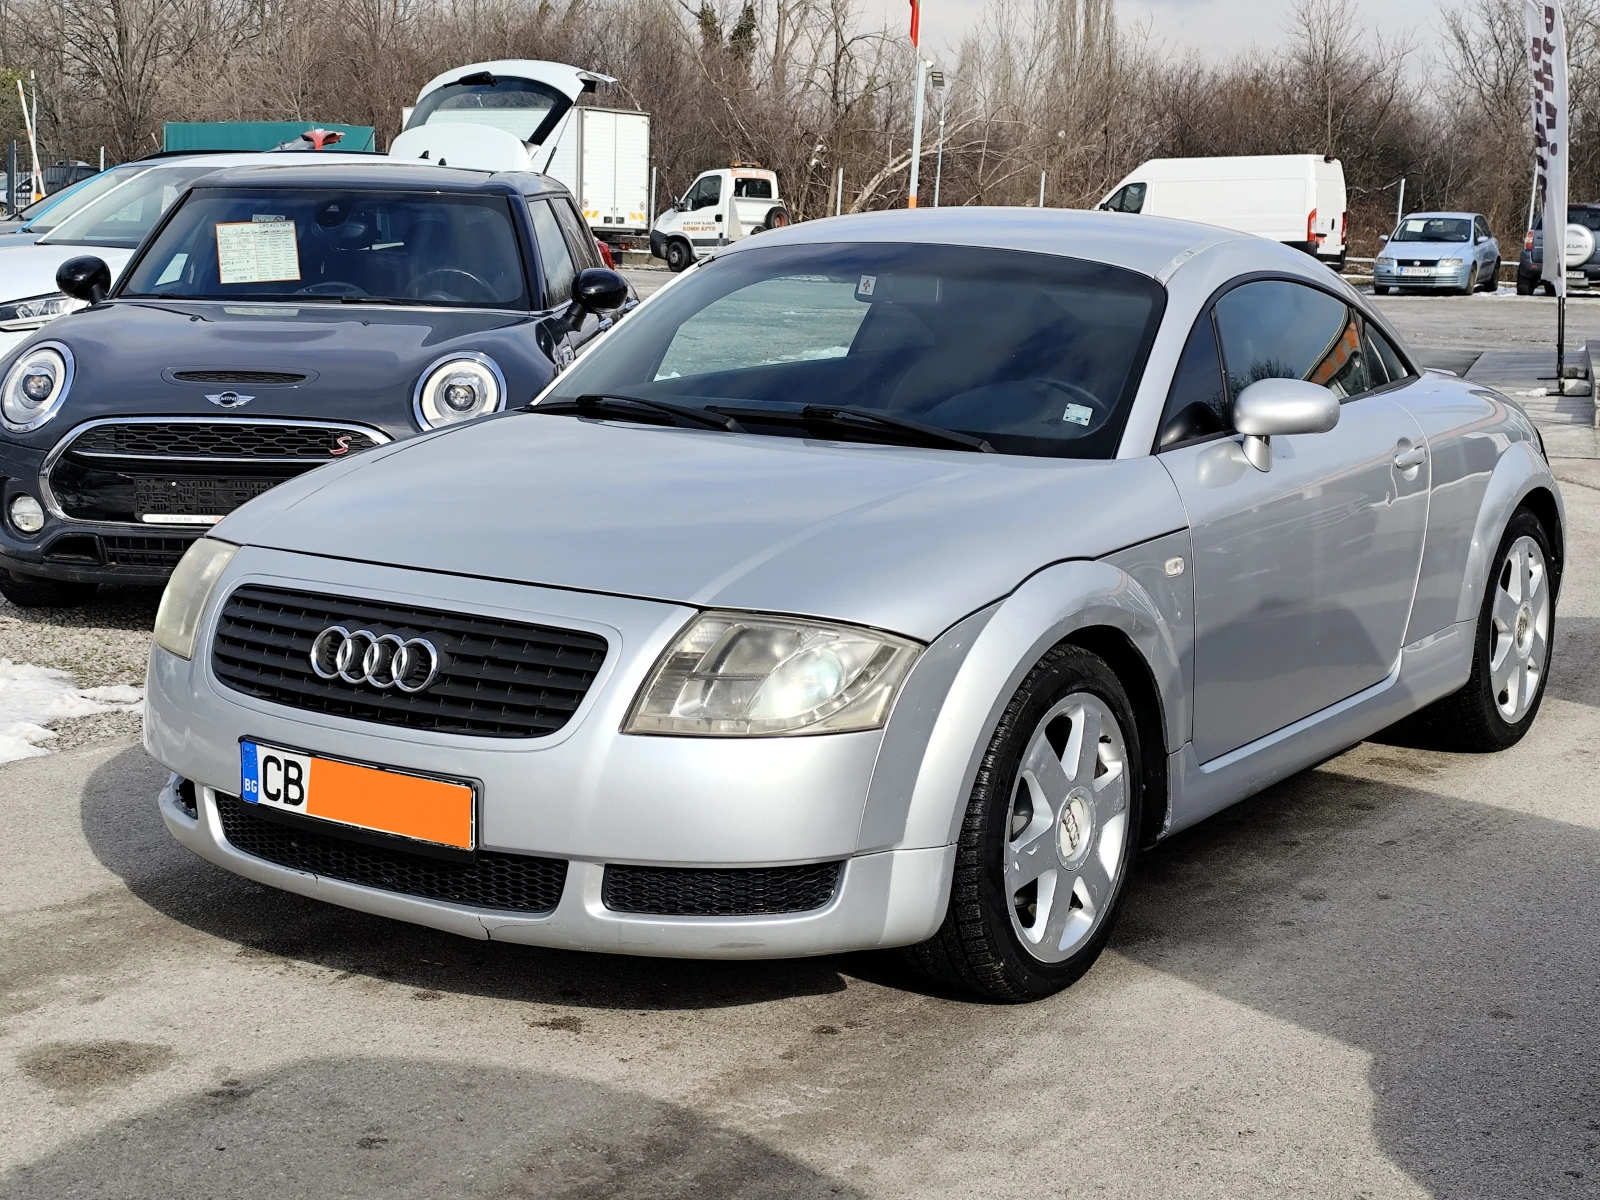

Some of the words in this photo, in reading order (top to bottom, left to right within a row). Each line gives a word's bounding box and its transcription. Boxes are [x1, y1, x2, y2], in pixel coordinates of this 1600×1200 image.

[731, 169, 753, 178] Bomi
[755, 171, 774, 179] Auto
[330, 436, 353, 455] S
[244, 777, 257, 793] BG
[263, 755, 304, 806] CB
